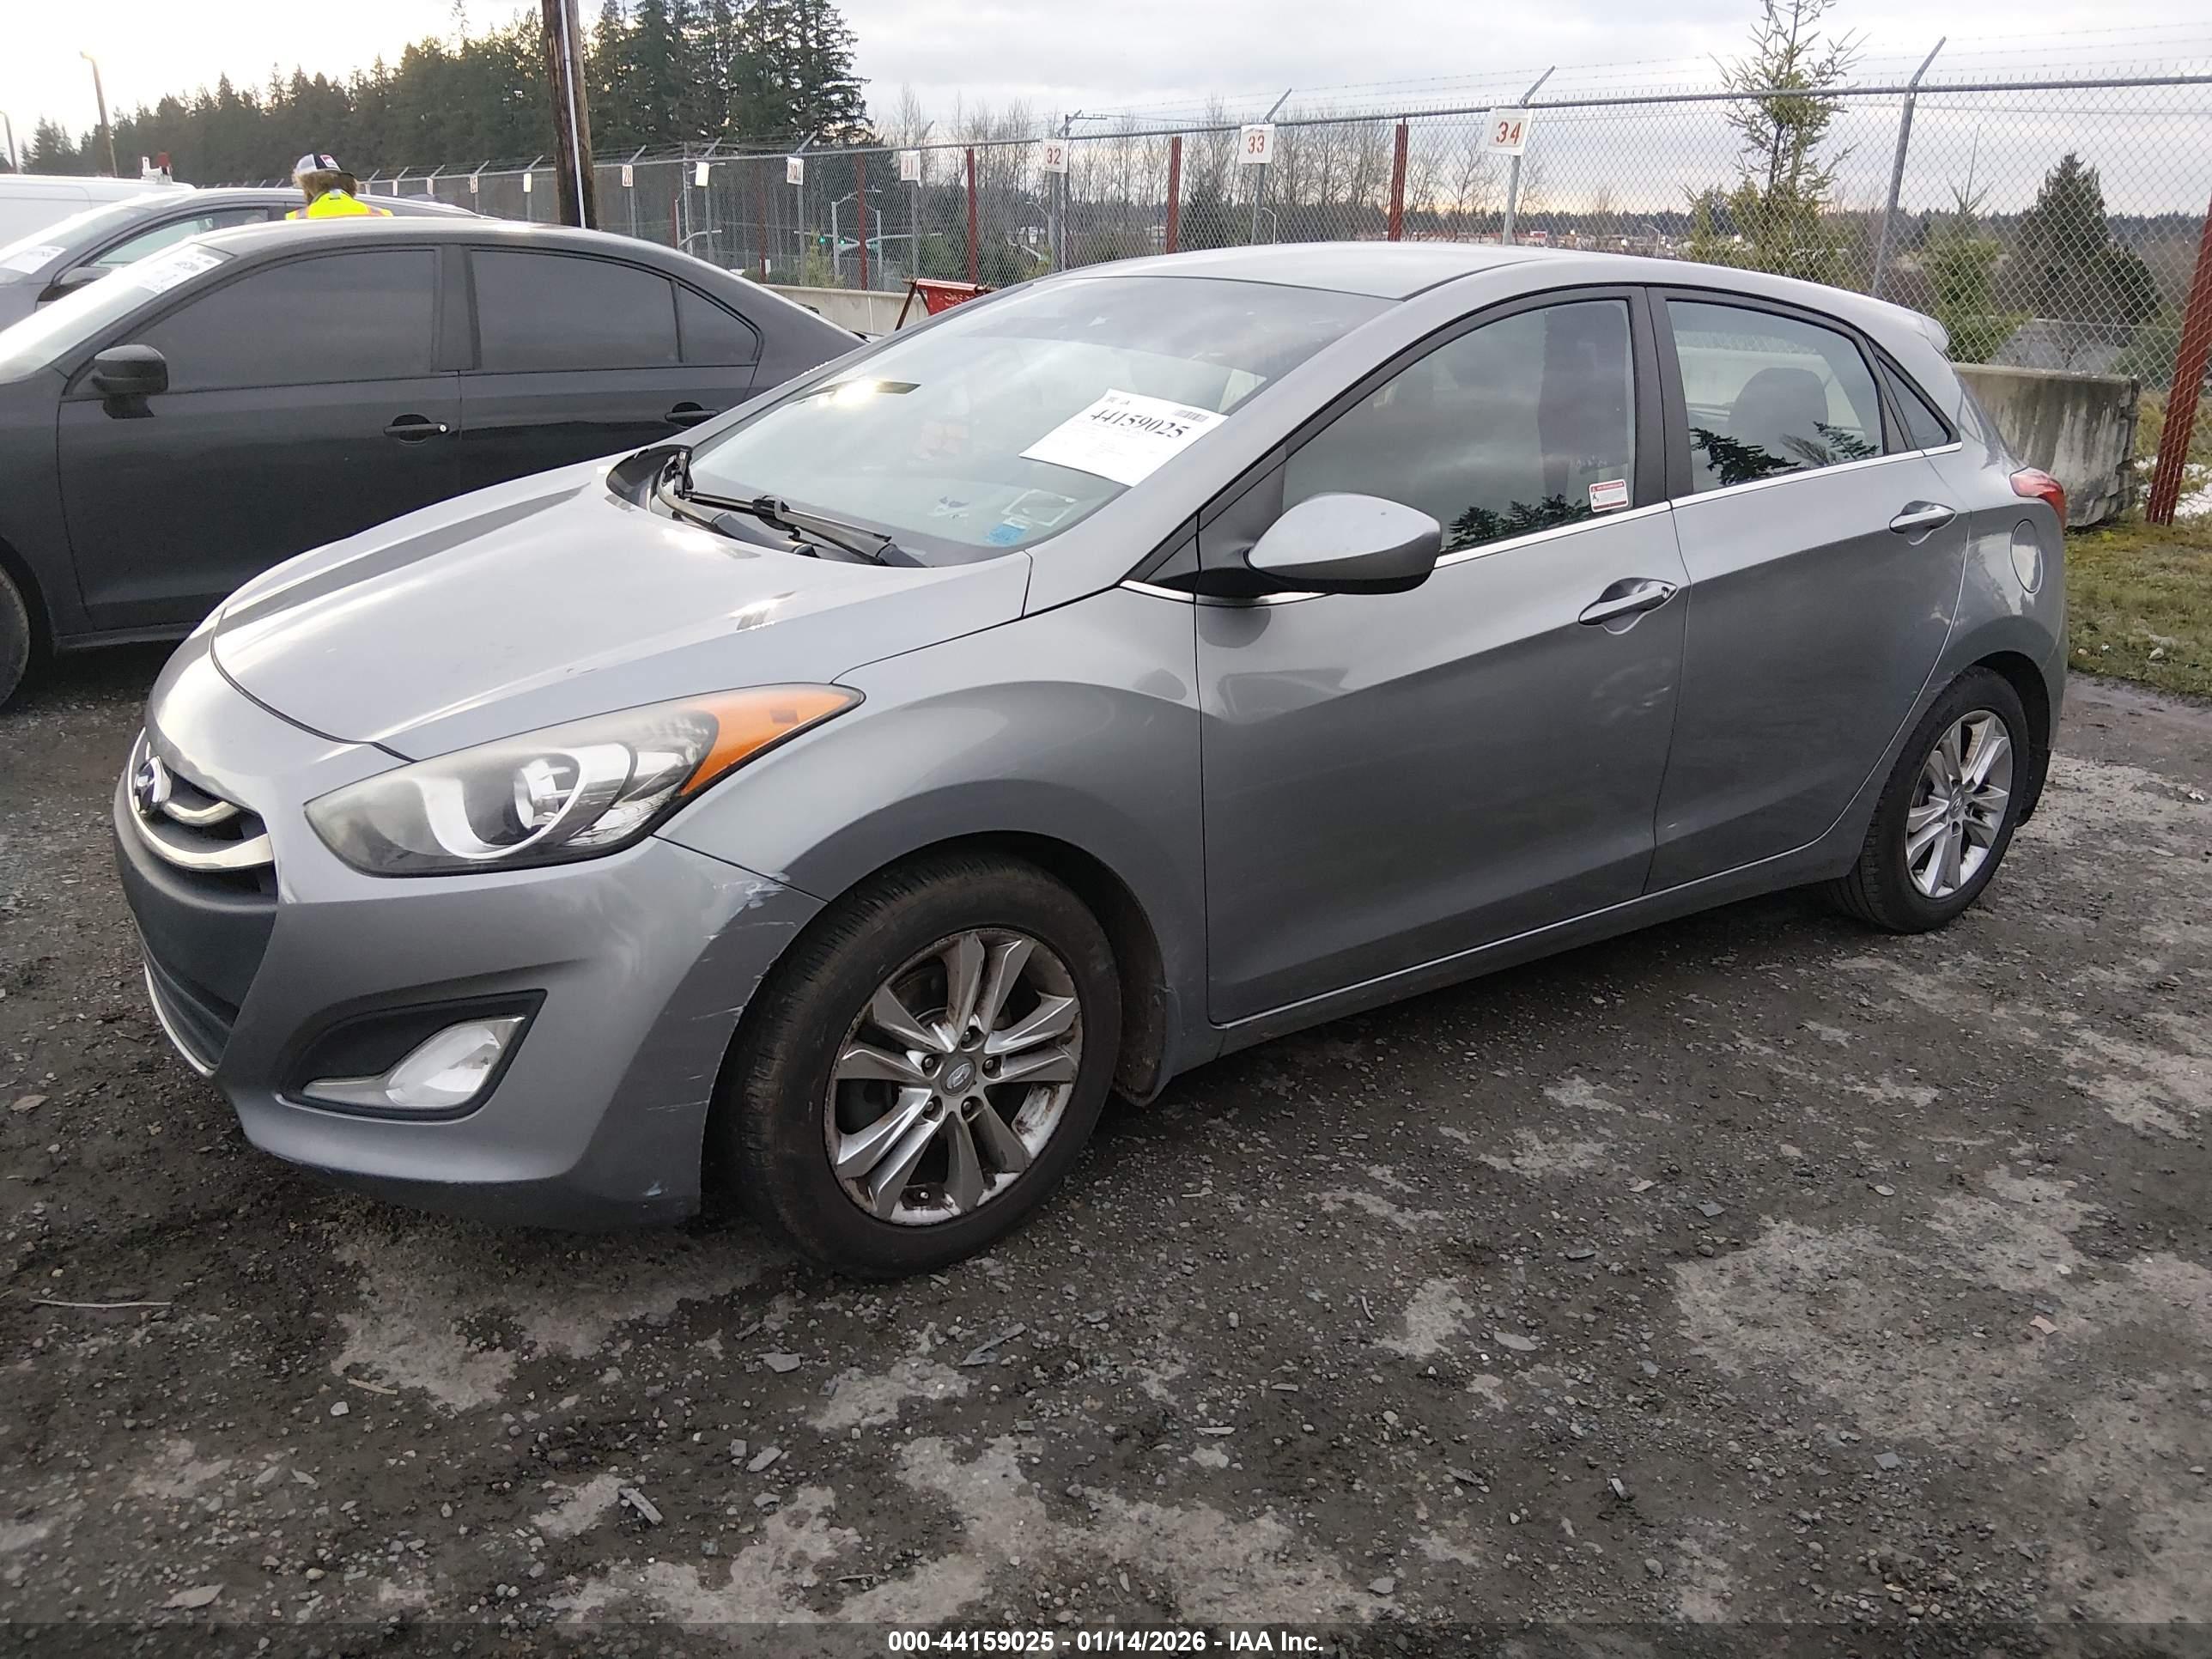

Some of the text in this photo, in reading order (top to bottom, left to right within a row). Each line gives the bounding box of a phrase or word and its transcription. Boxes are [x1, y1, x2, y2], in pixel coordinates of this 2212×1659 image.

[1496, 120, 1522, 145] 34
[1248, 134, 1266, 155] 33
[1047, 147, 1061, 165] 32
[623, 167, 632, 185] 28
[1090, 409, 1191, 438] 44159025
